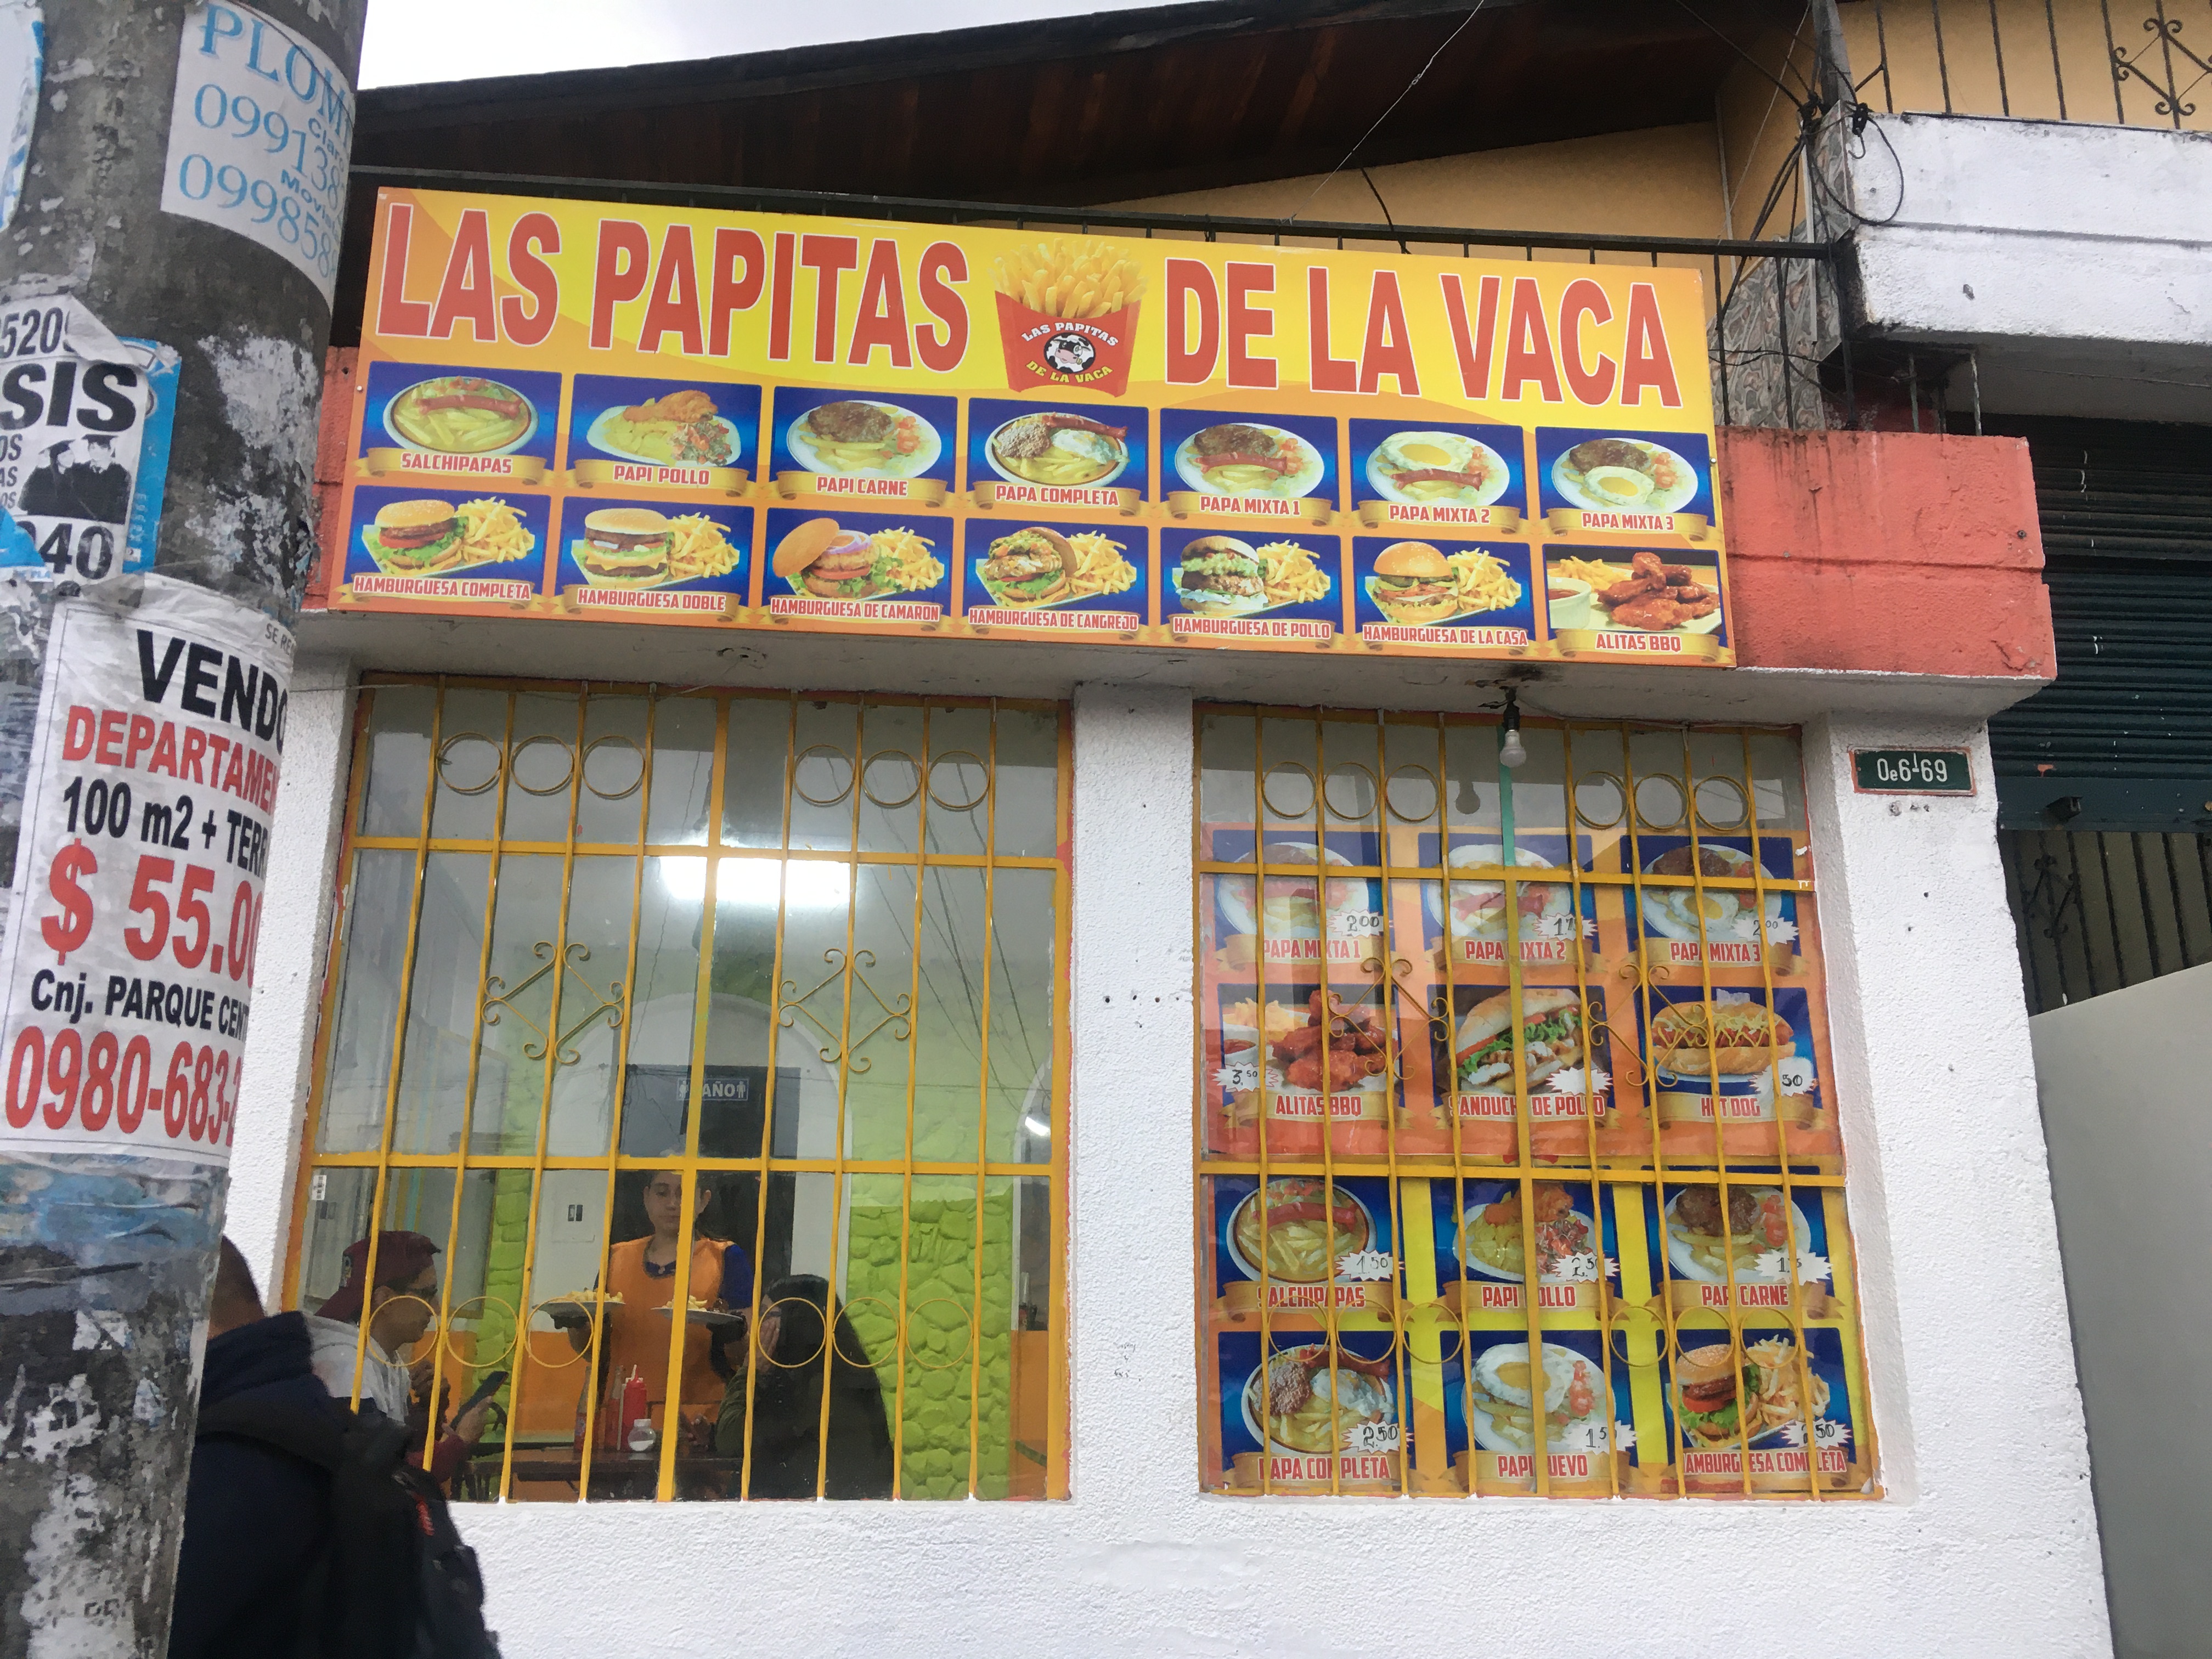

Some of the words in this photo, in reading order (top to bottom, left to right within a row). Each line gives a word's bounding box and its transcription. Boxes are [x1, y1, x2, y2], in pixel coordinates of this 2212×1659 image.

[194, 83, 346, 211] 099138
[376, 203, 561, 346] LAS
[589, 218, 970, 373] PAPITAS
[1165, 257, 1278, 390] DE
[1307, 266, 1423, 397] LA
[1439, 273, 1684, 408] VACA
[1022, 324, 1051, 341] LAS
[1054, 322, 1119, 346] PAPITAS
[1026, 360, 1047, 377] DE
[1049, 371, 1070, 383] LA
[1075, 366, 1113, 383] VACA
[400, 452, 512, 475] SALCHIPAPAS
[613, 464, 653, 483] PAPI
[658, 466, 710, 486] POLLO
[816, 476, 855, 494] PAPI
[857, 478, 909, 497] CARNE
[995, 485, 1037, 504] PAPA
[1040, 487, 1119, 506] COMPLETA
[1200, 495, 1242, 514] PAPA
[1244, 497, 1291, 516] MIXTA
[1292, 499, 1301, 516] 1
[1389, 504, 1429, 522] PAPA
[1432, 506, 1478, 524] MIXTA
[1480, 508, 1491, 524] 2
[1582, 512, 1621, 529] PAPA
[1622, 514, 1663, 531] MIXTA
[1665, 516, 1674, 531] 3
[16, 521, 114, 579] 40
[352, 575, 459, 597] HAMBURGUESA
[461, 581, 532, 601] COMPLETA
[577, 589, 681, 610] HAMBURGUESA
[682, 592, 726, 612] DOBLE
[771, 598, 864, 618] HAMBURGUESA
[864, 602, 879, 619] DE
[880, 602, 940, 622] CAMARON
[968, 607, 1059, 628] HAMBURGUESA
[1059, 611, 1075, 629] DE
[1076, 611, 1139, 631] CANGREJO
[1173, 617, 1269, 636] HAMBURGUESA
[1271, 620, 1288, 637] DE
[1291, 621, 1331, 639] POLLO
[265, 623, 279, 645] SE
[1362, 625, 1459, 644] HAMBURGUESA
[1460, 629, 1477, 645] DE
[1479, 629, 1494, 645] LA
[1496, 629, 1528, 646] CASA
[1596, 634, 1647, 651] ALITAS
[1650, 635, 1681, 653] BBQ
[137, 629, 287, 755] VENDO
[63, 776, 131, 838] 100
[140, 794, 193, 850] m2
[201, 810, 216, 849] +
[41, 838, 98, 966] $
[1346, 915, 1380, 932] 2.00
[1554, 917, 1576, 936] 1.7
[1263, 939, 1301, 958] PAPA
[1353, 940, 1361, 958] 1
[1465, 941, 1504, 960] PAPA
[1507, 941, 1553, 960] IXTA
[1556, 941, 1566, 960] 2
[1709, 943, 1751, 962] MIXTA
[1752, 944, 1761, 962] 3
[31, 969, 92, 1024] Cnj.
[105, 975, 215, 1030] PARQUE
[1232, 1069, 1258, 1085] 3.50
[702, 1081, 735, 1097] AÑO
[1276, 1095, 1324, 1115] ALITAS
[1330, 1096, 1362, 1116] BBQ
[1448, 1096, 1517, 1116] ANDUCH
[1532, 1096, 1551, 1116] DE
[1555, 1096, 1605, 1116] POLO
[1731, 1098, 1760, 1117] DOG
[1357, 1256, 1388, 1274] 1.50
[1482, 1286, 1519, 1307] PAPI
[1525, 1286, 1576, 1307] OLLO
[1701, 1285, 1736, 1306] PAP
[1740, 1285, 1788, 1306] CARNE
[1363, 1426, 1397, 1447] 2.50
[1586, 1427, 1617, 1448] 1.5
[1497, 1455, 1534, 1477] PAPI
[1546, 1455, 1588, 1477] UEVO
[1684, 1453, 1775, 1473] AMBURGESA
[1776, 1451, 1847, 1472] COMLETA
